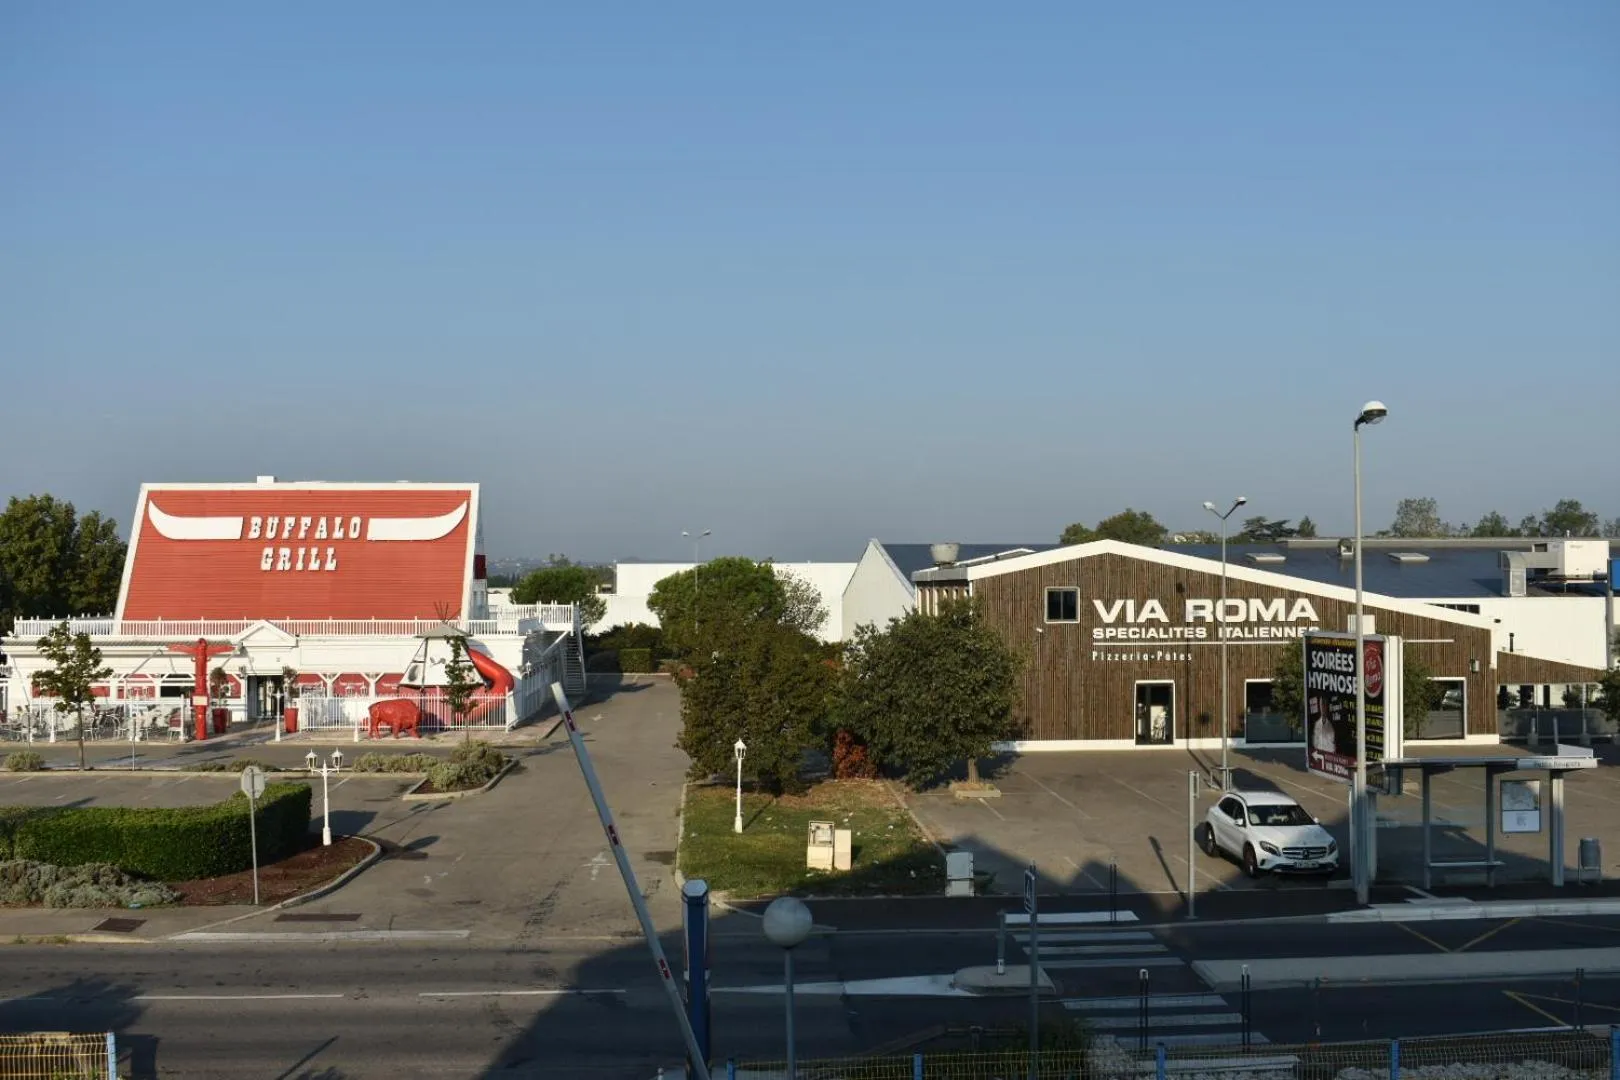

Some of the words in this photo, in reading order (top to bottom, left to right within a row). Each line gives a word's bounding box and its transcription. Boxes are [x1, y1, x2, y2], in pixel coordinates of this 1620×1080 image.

[247, 516, 362, 540] BUFFALO
[260, 547, 338, 571] GRILL
[1092, 599, 1169, 623] VIA
[1185, 598, 1320, 623] ROMA
[1092, 627, 1208, 639] SPECIALITES
[1311, 649, 1354, 673] SOIRÉES
